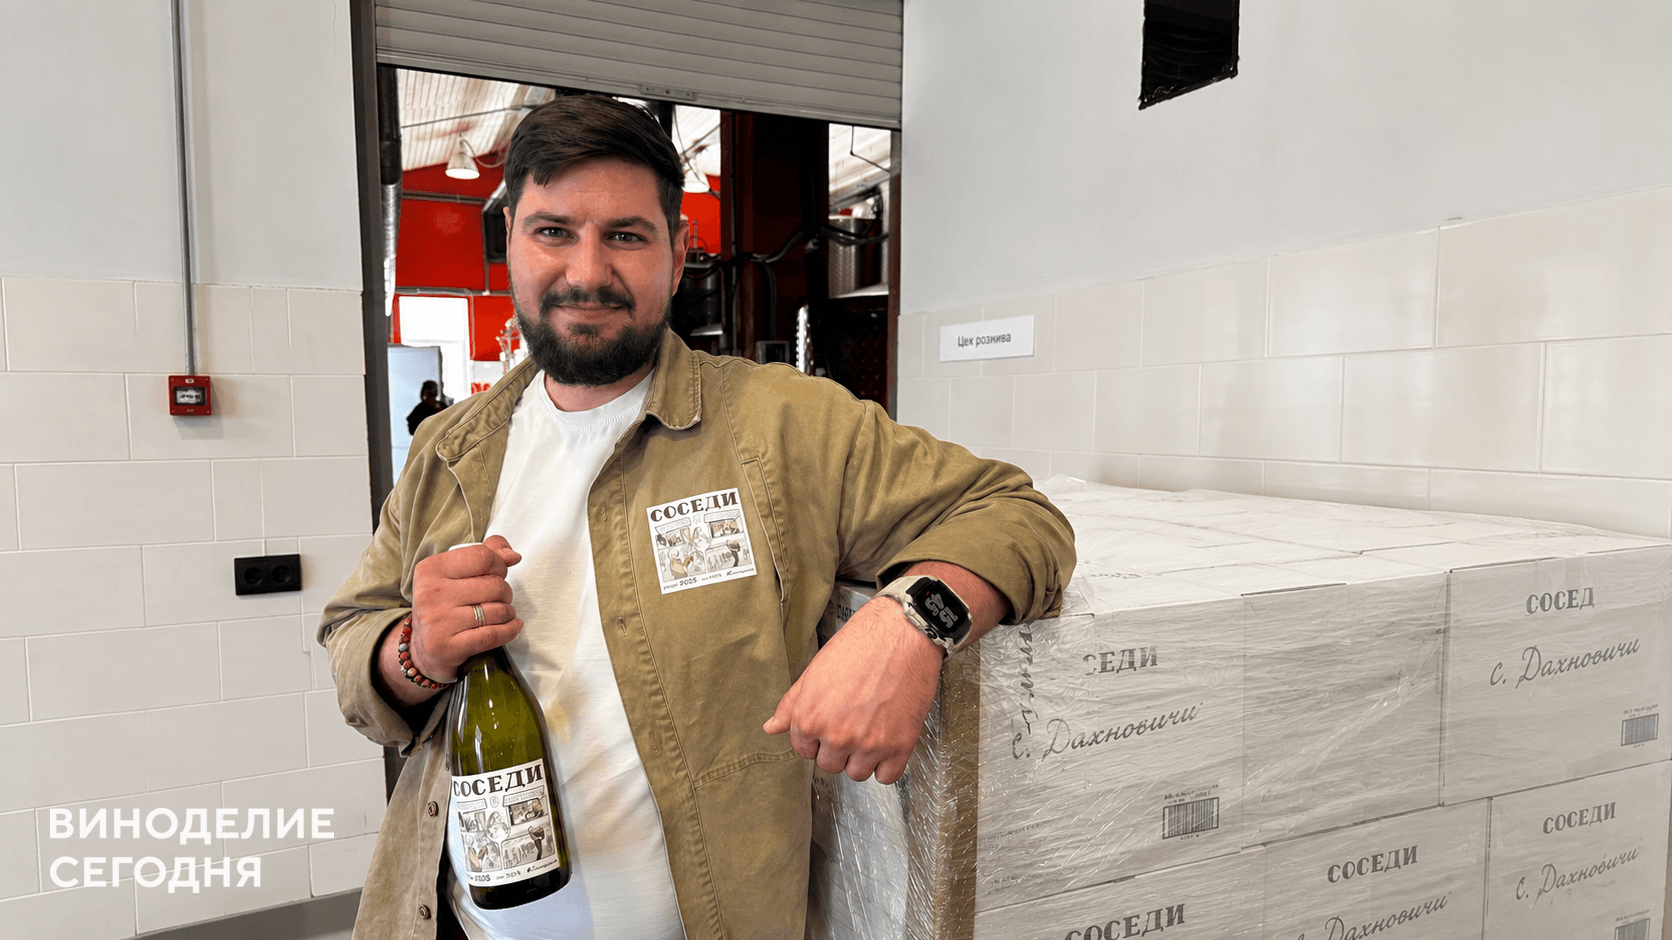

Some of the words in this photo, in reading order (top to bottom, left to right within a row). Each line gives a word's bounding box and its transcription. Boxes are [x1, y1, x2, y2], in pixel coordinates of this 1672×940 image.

[650, 492, 738, 522] СОСЕДИ
[1515, 639, 1641, 689] Дахновичи
[1042, 704, 1201, 762] Дахновичи
[453, 764, 543, 797] СОСЕДИ
[1543, 802, 1616, 834] СОСЕДИ
[1327, 845, 1418, 883] СОСЕДИ
[1531, 848, 1639, 910] Дахновичи
